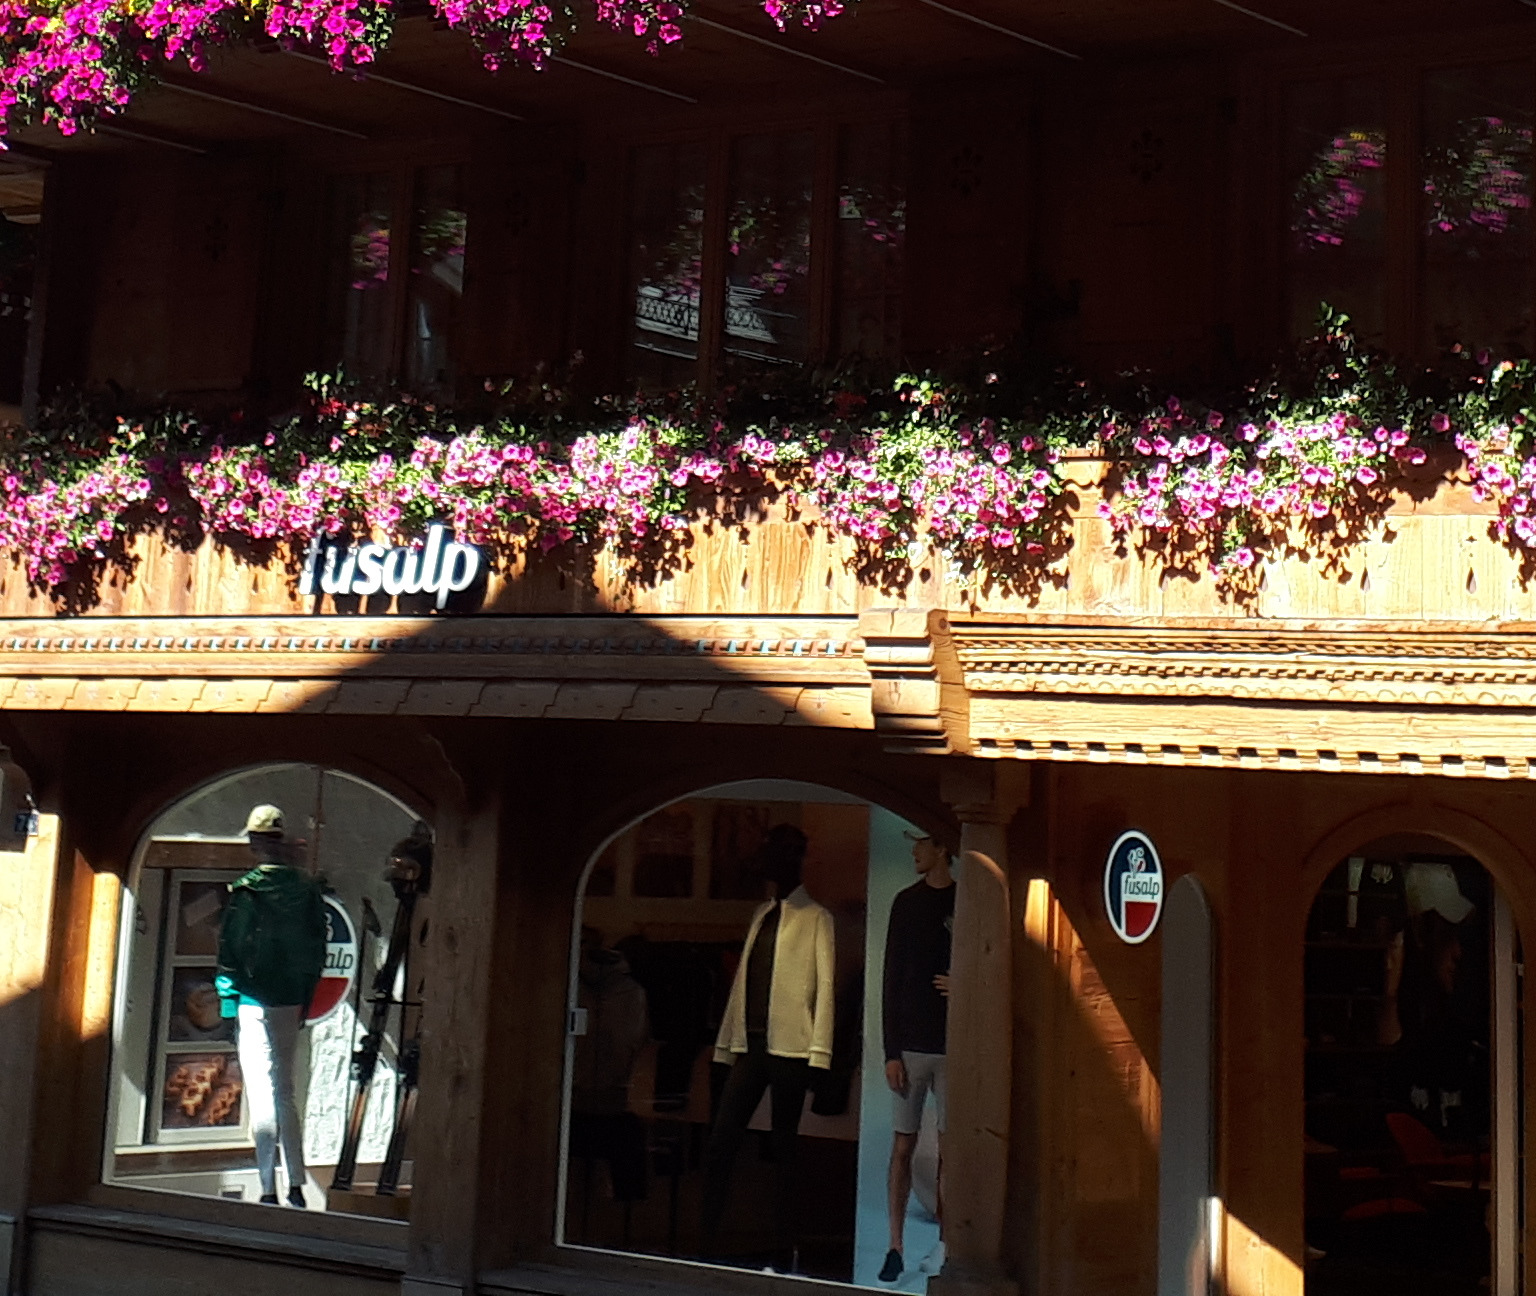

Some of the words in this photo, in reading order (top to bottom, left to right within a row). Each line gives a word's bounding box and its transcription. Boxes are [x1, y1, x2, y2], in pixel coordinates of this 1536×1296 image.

[298, 524, 480, 610] fusalp
[1124, 875, 1160, 900] fusalp
[324, 947, 354, 975] alp
